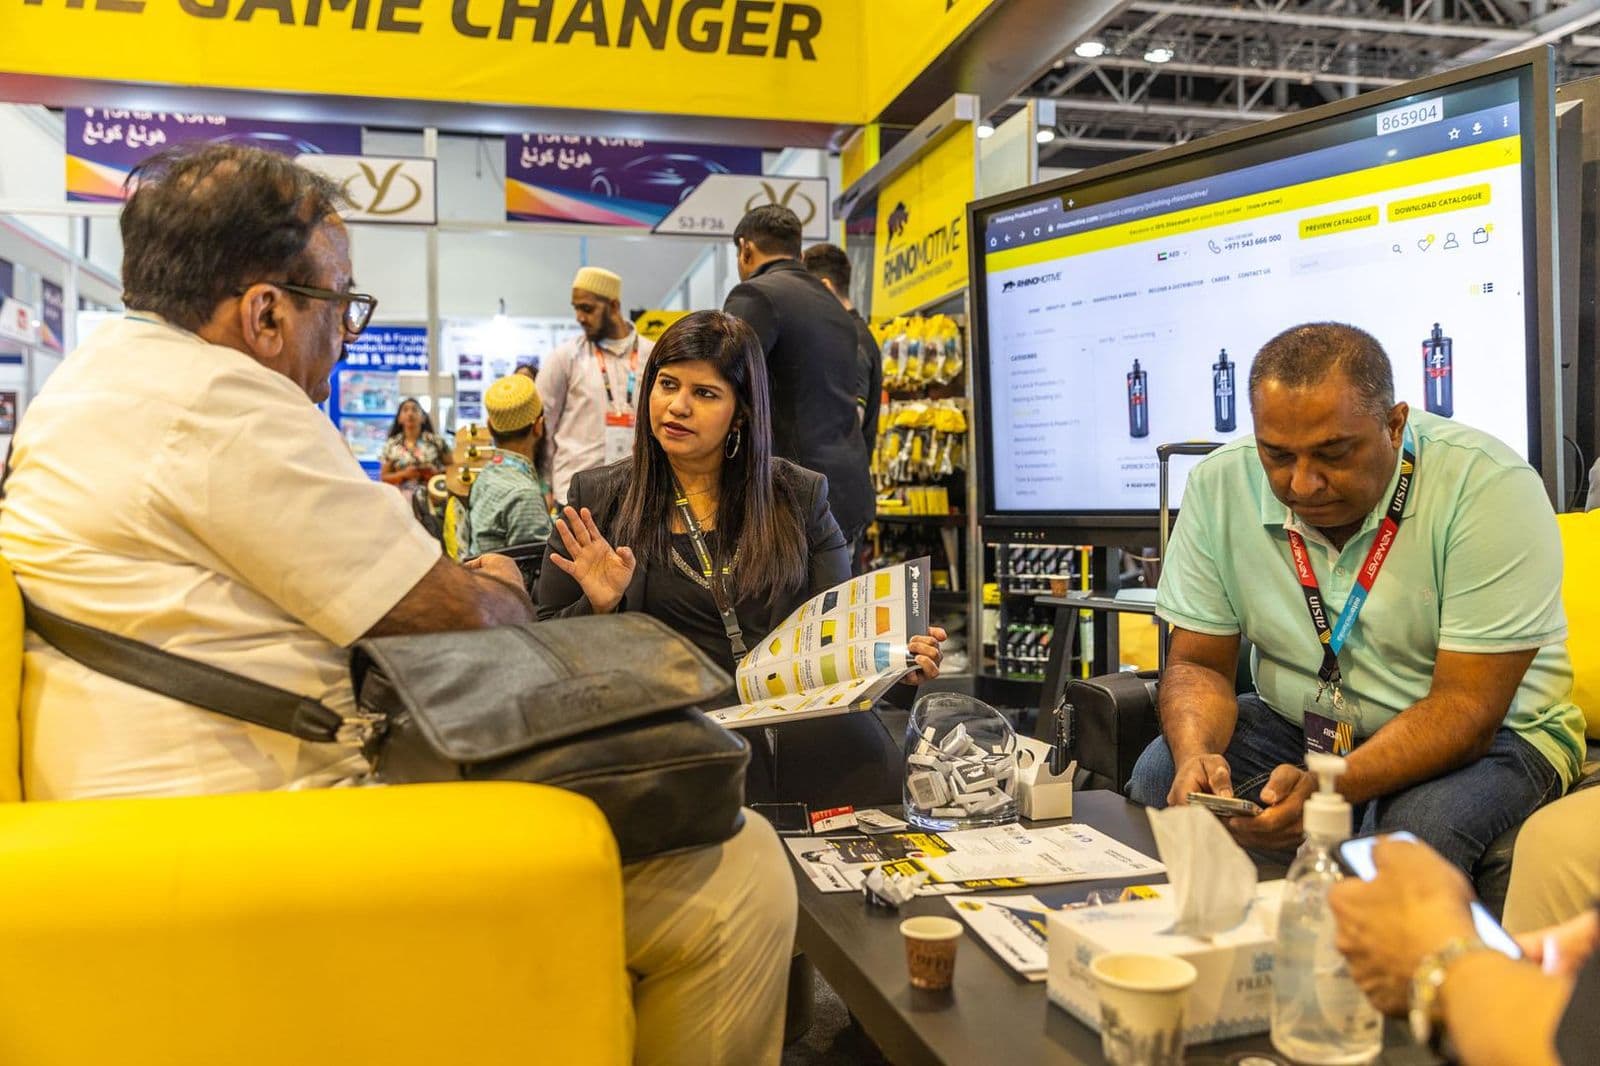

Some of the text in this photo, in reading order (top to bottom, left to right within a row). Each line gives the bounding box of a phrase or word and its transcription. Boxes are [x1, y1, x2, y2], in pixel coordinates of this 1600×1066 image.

[450, 0, 823, 62] CHANGER
[1381, 104, 1438, 132] 865904
[1395, 192, 1482, 216] DOWNLOAD CATALOGUE
[1306, 213, 1371, 233] PREVIEW CATALOGUE
[1392, 475, 1410, 514] AISIN
[1366, 529, 1393, 579] NEWEAST
[1308, 595, 1326, 630] AISIN
